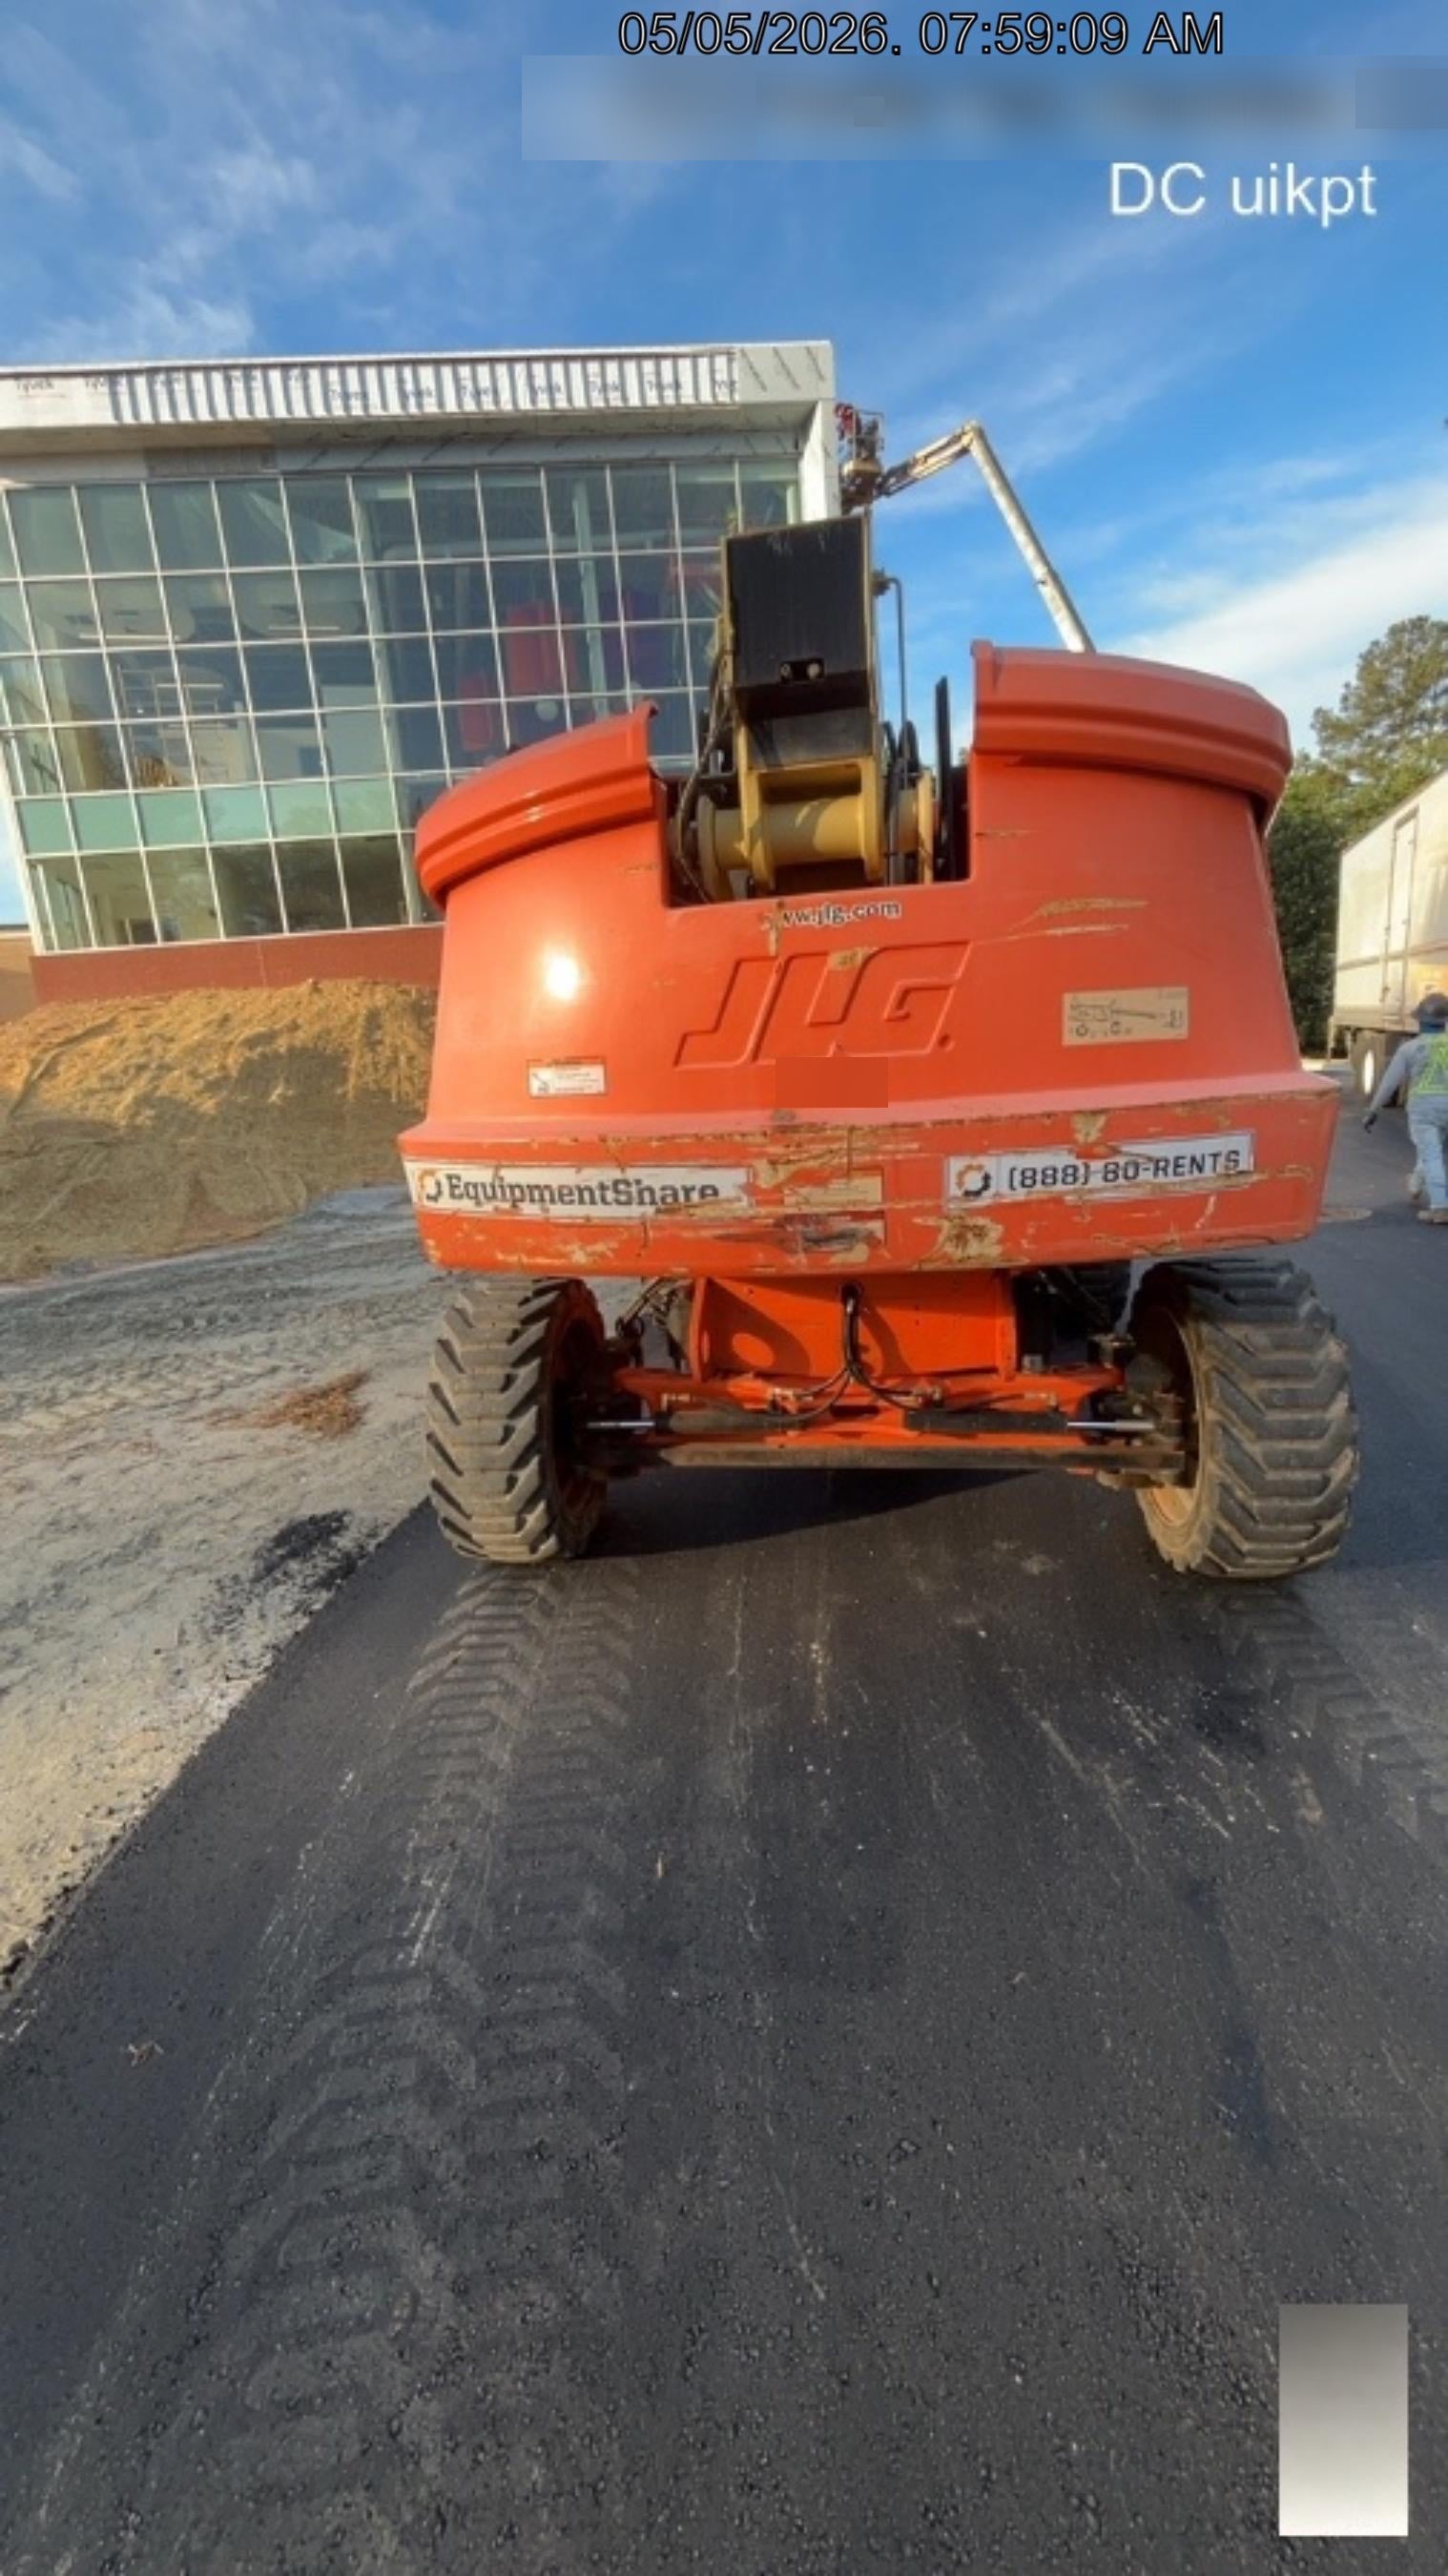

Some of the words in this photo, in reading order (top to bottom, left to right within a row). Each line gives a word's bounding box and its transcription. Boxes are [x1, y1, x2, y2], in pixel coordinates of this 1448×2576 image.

[673, 942, 972, 1069] JLG
[445, 1173, 719, 1208] EquipmentShare
[1008, 1162, 1090, 1191] (888)
[1102, 1150, 1240, 1183] 80-RENTS
